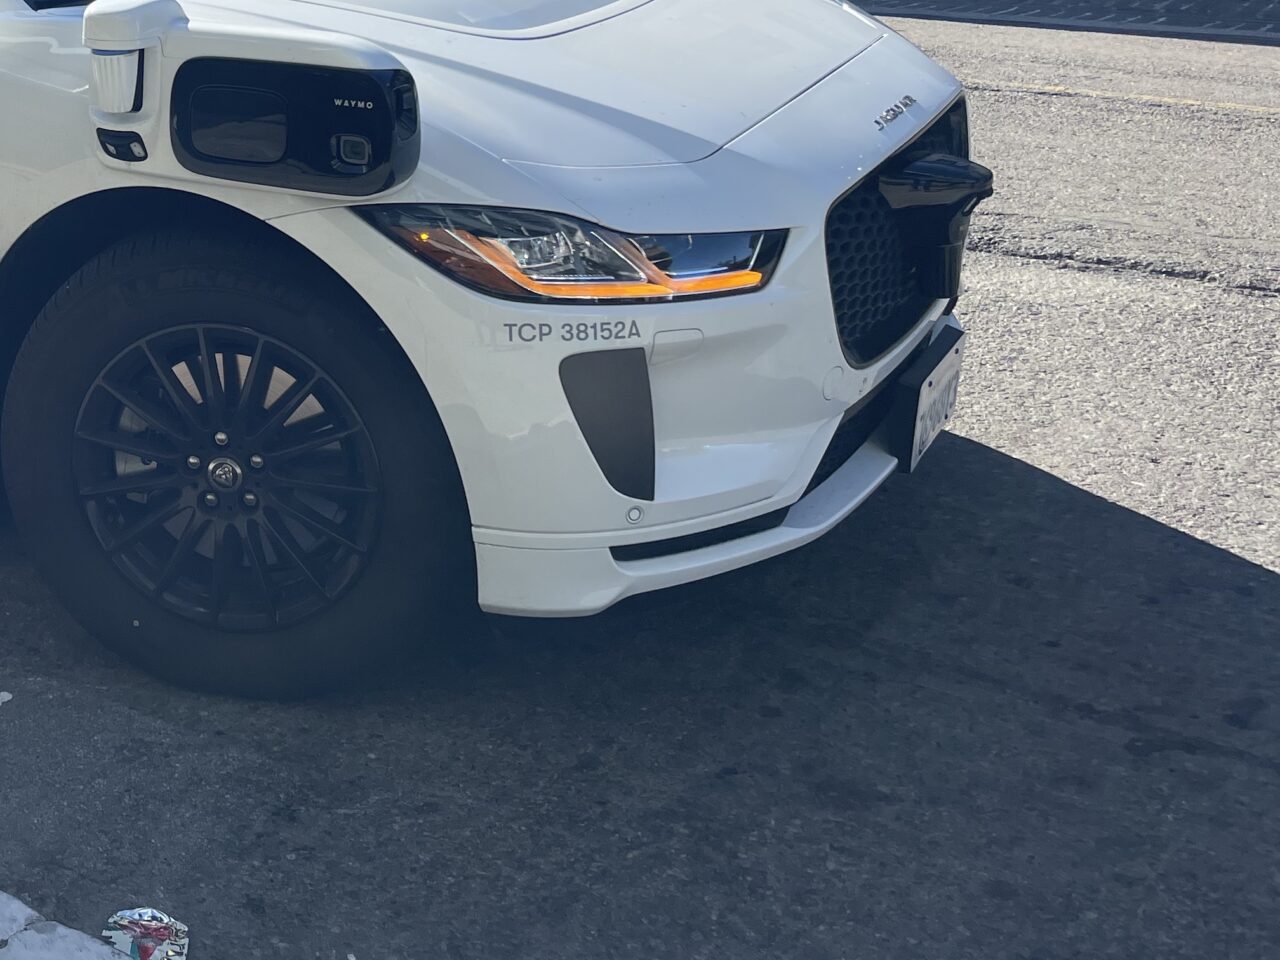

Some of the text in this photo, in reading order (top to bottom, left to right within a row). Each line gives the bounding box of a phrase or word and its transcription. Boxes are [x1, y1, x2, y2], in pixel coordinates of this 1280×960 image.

[333, 98, 373, 109] WAYMO
[503, 319, 642, 342] TCP 38152A
